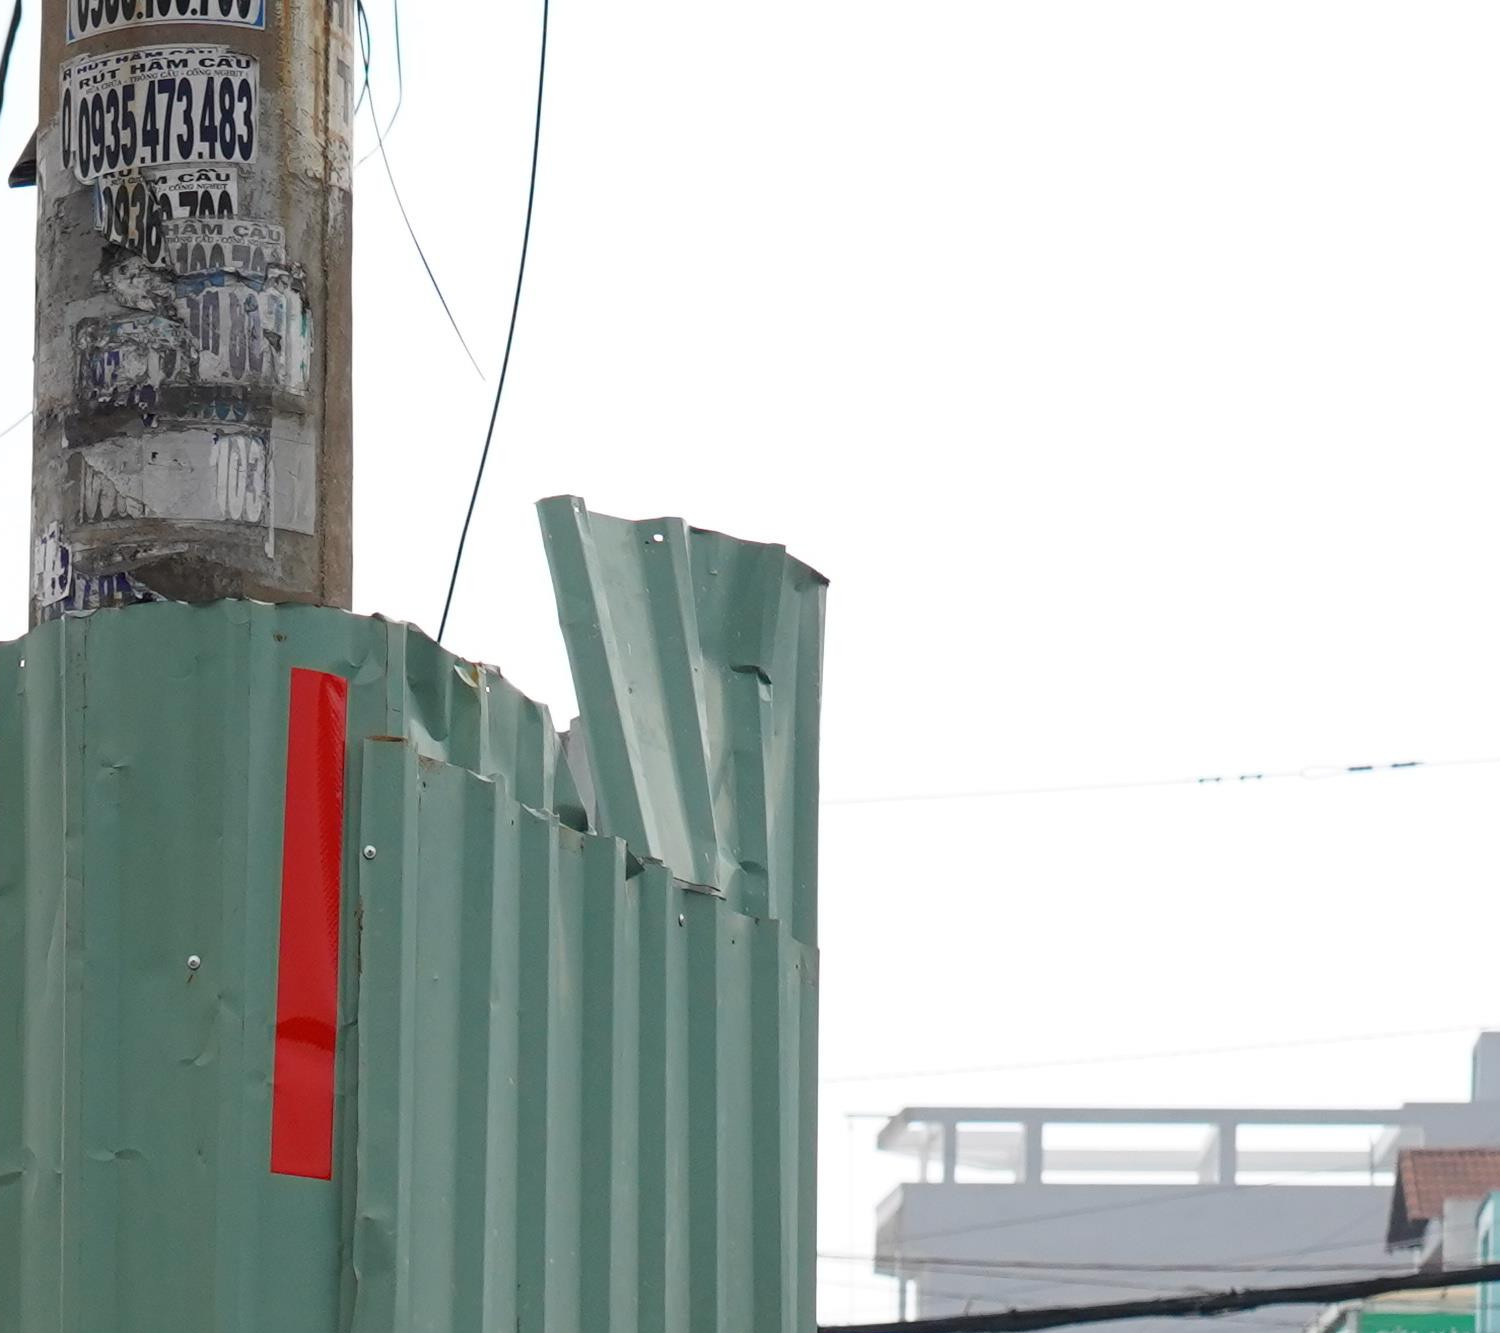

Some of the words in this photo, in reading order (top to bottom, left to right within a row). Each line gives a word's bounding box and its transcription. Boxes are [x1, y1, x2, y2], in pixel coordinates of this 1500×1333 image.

[79, 68, 120, 90] RÚT
[130, 56, 188, 75] HẦM
[198, 55, 251, 69] CẦU
[129, 70, 158, 84] THÔNG
[78, 76, 254, 178] 0935.473.483
[178, 169, 231, 183] CẦU
[163, 219, 224, 236] HẦM
